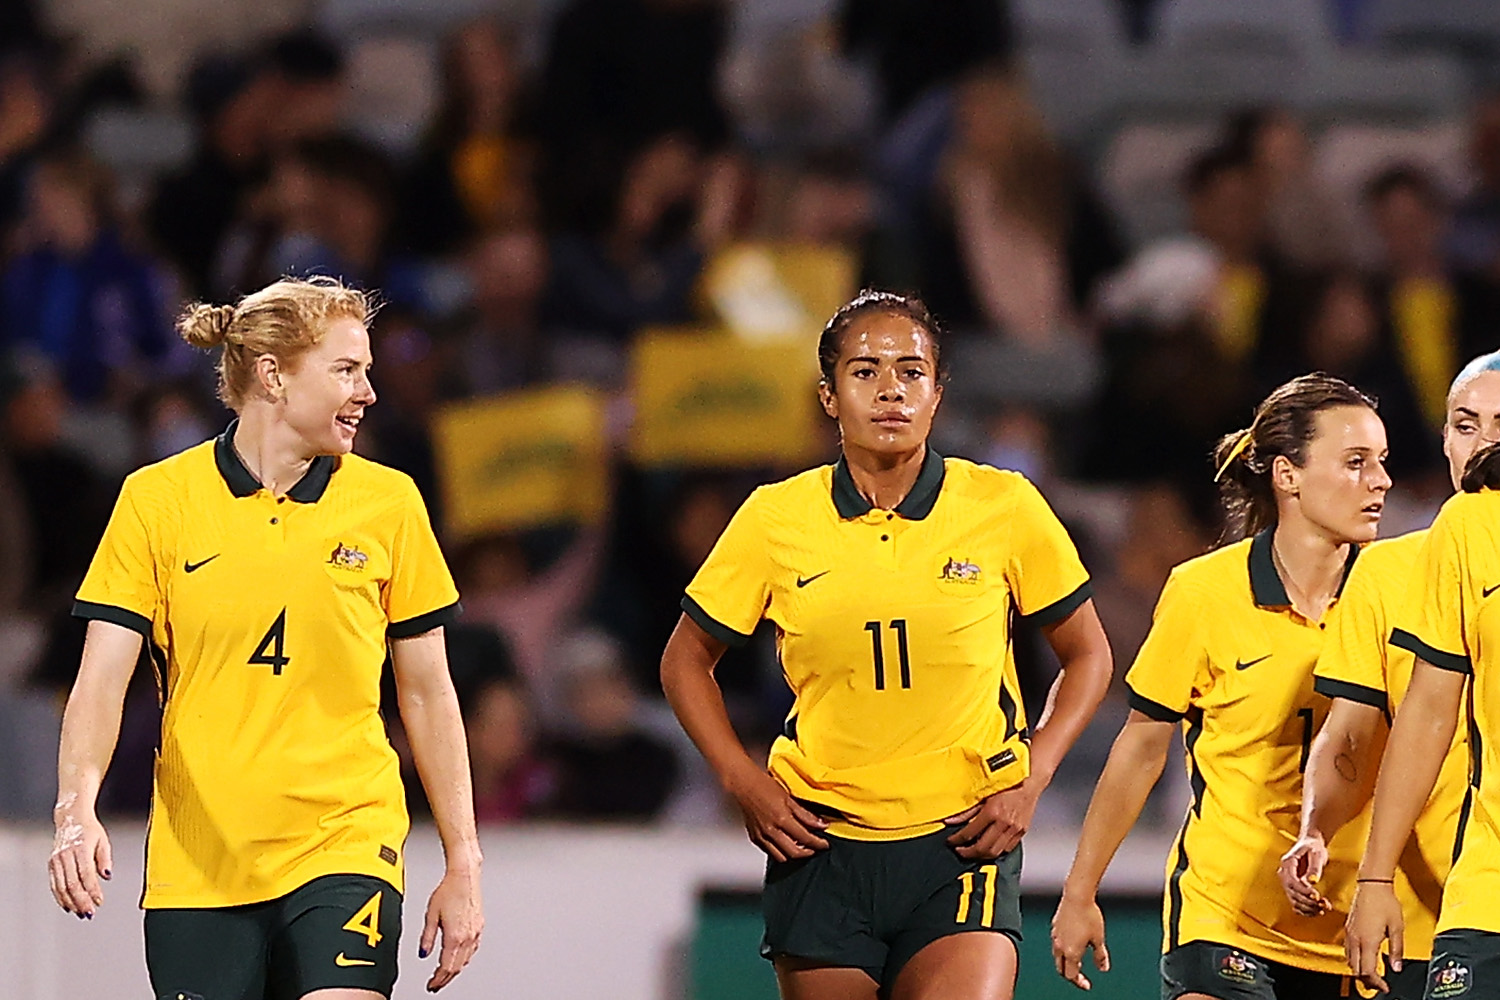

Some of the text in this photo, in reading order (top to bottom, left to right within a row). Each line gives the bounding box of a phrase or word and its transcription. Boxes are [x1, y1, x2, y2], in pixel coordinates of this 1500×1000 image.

[247, 605, 290, 675] 4
[864, 619, 911, 691] 11
[342, 890, 383, 948] 4
[956, 865, 998, 928] 11
